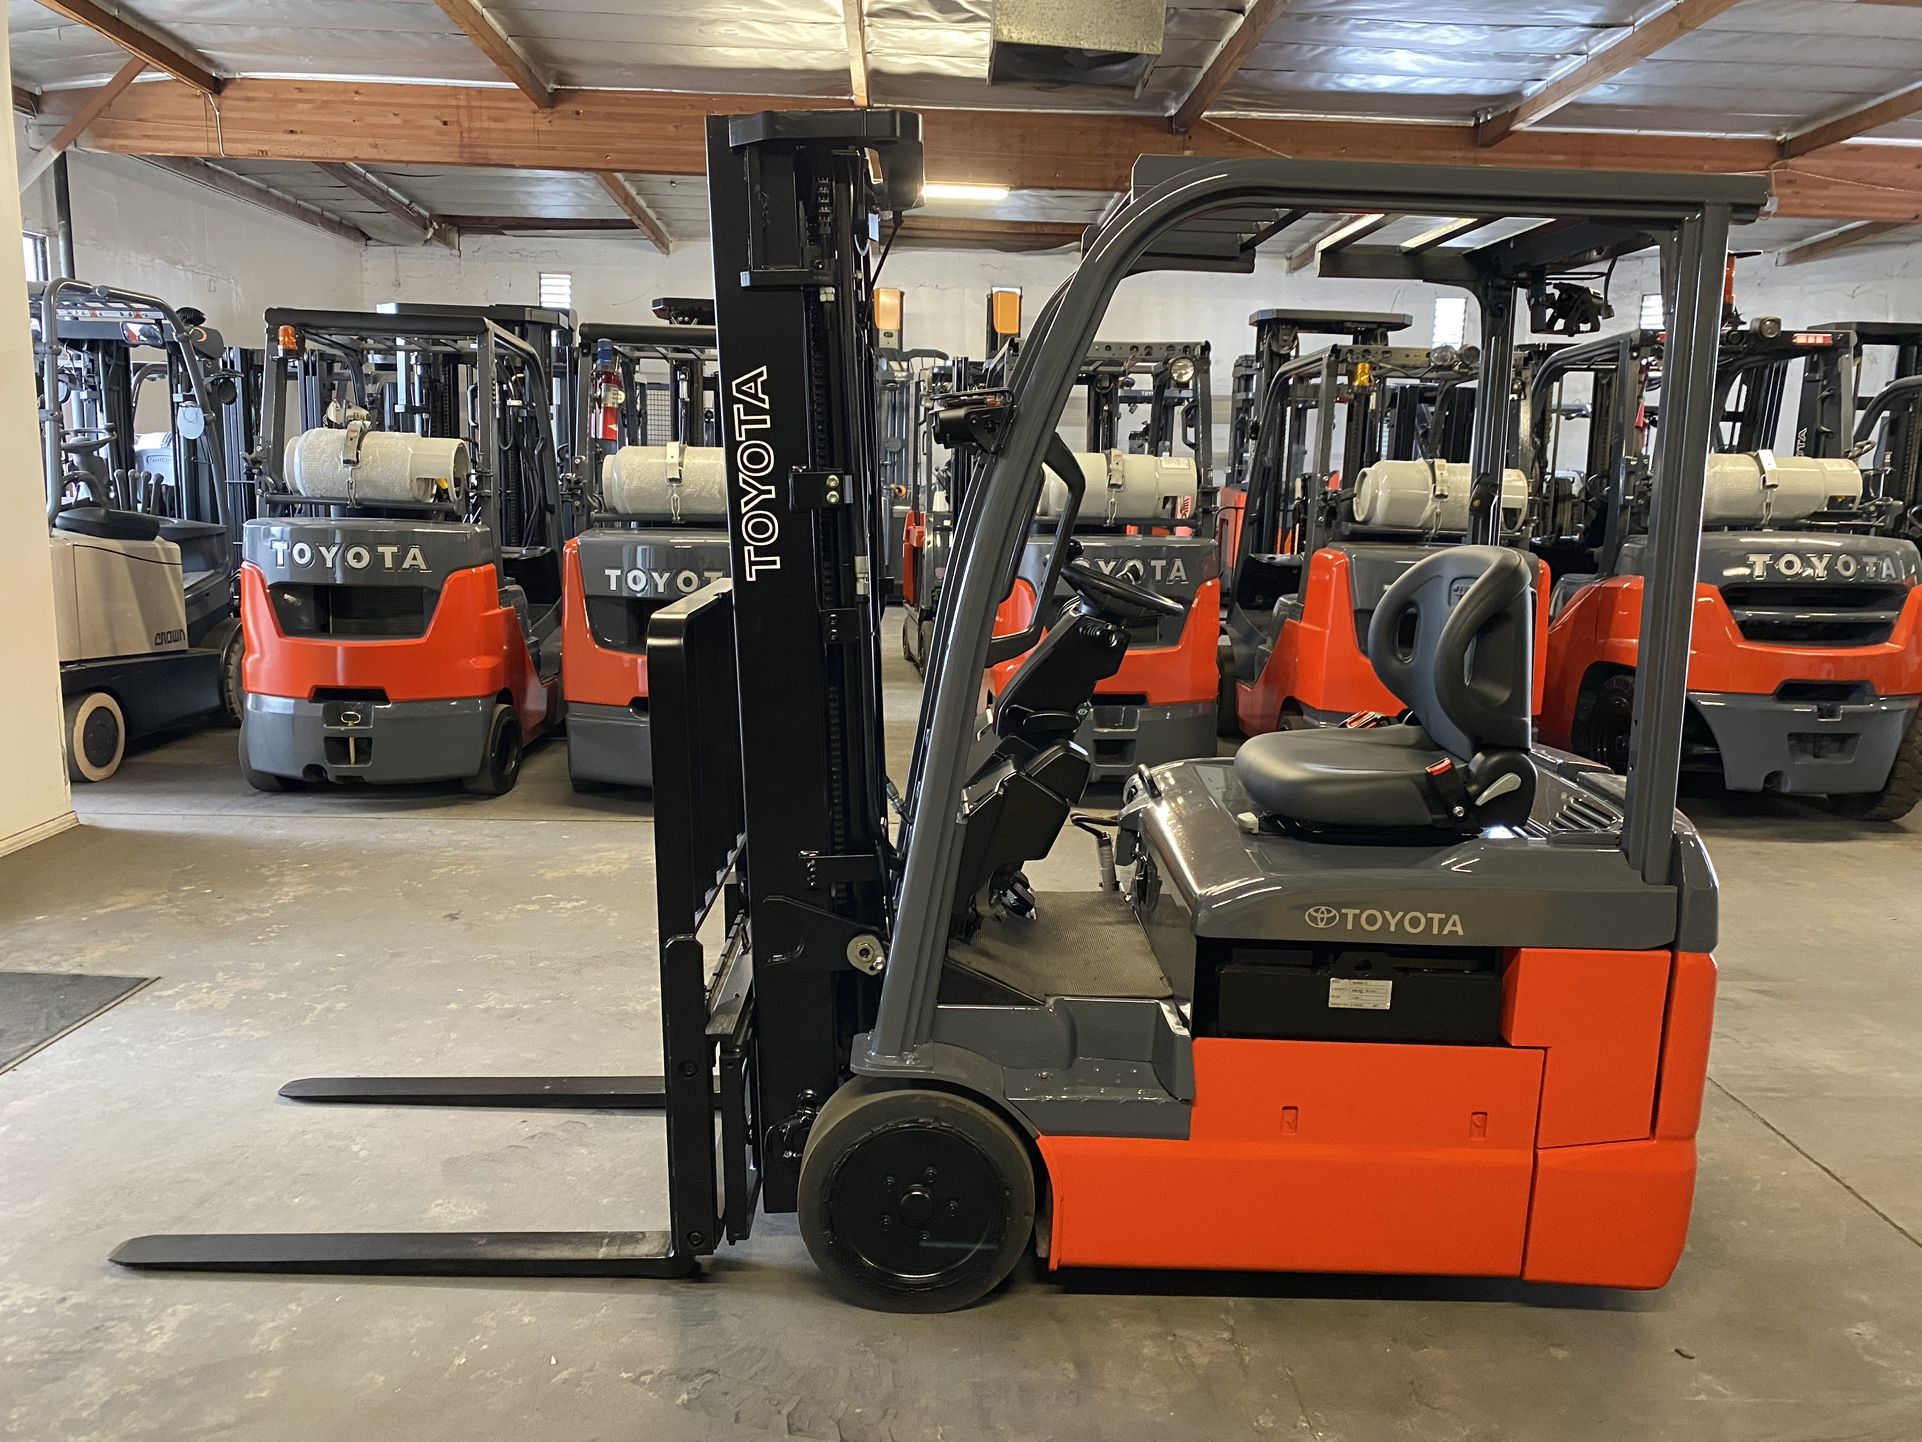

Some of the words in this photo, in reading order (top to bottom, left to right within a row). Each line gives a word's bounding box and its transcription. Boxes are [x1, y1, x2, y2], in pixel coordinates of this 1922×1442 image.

[732, 365, 781, 581] TOYOTA
[270, 540, 430, 572] TOYOTA
[1747, 553, 1898, 580] TOYOTA
[603, 568, 724, 593] TOYOT
[1341, 908, 1465, 936] TOYOTA
